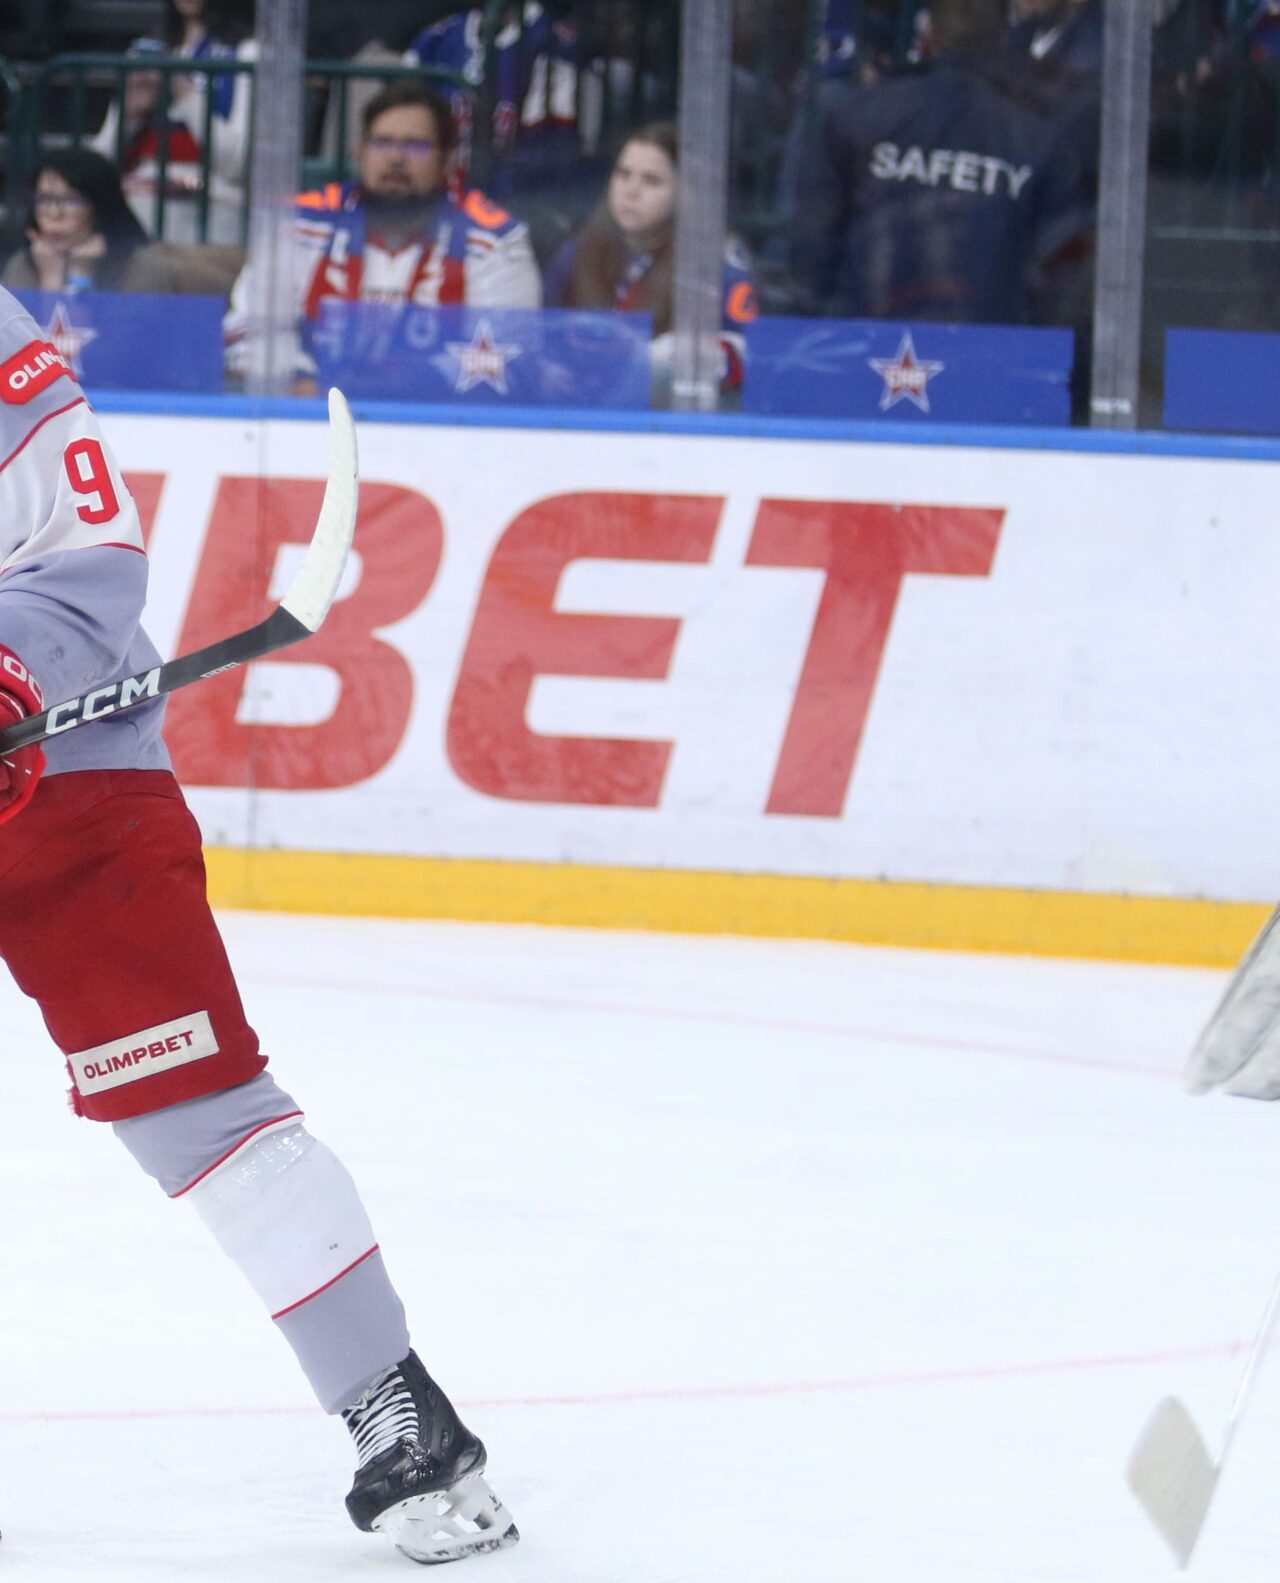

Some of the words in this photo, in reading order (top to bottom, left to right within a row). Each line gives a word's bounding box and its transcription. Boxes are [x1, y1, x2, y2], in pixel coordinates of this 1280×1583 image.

[870, 142, 1032, 199] SAFETY
[63, 436, 133, 525] 9
[45, 666, 162, 735] CCM
[84, 1030, 193, 1079] OLIMPBET
